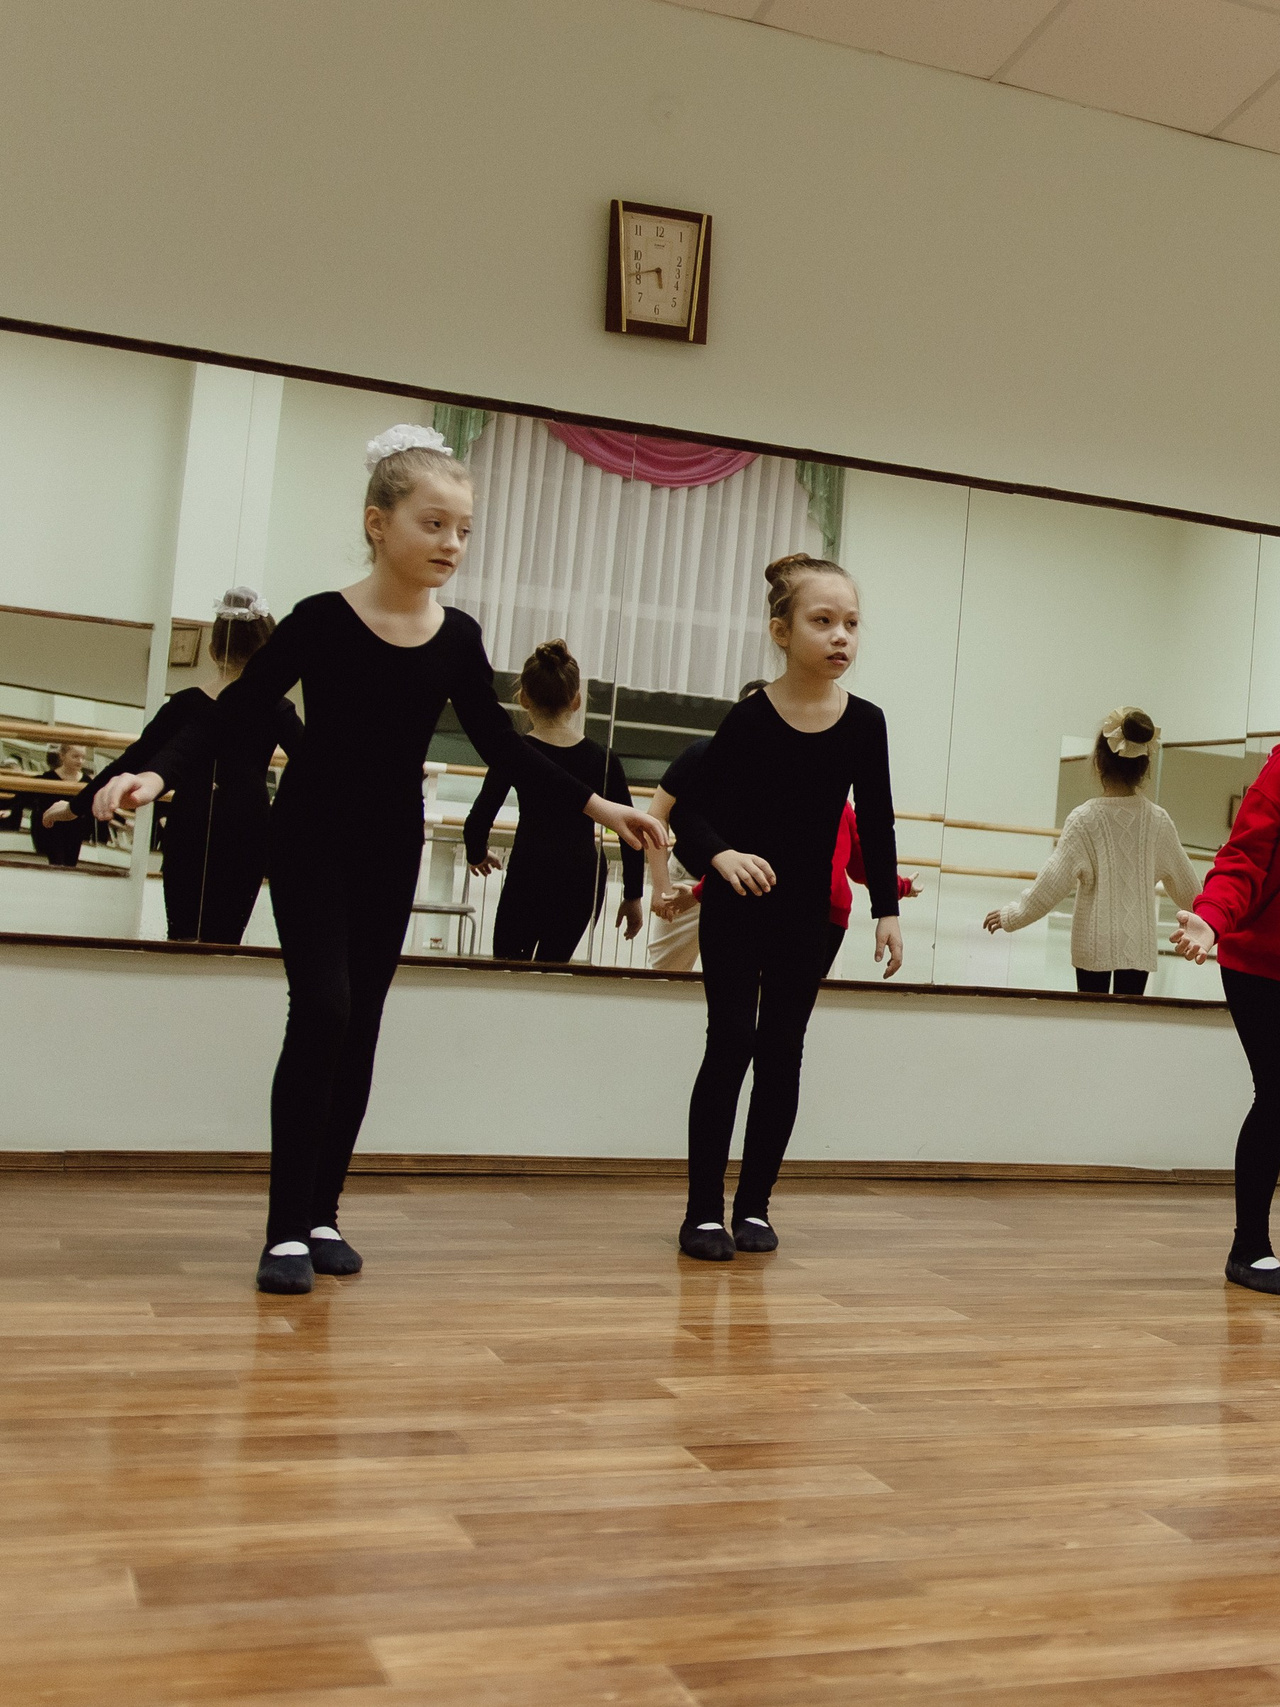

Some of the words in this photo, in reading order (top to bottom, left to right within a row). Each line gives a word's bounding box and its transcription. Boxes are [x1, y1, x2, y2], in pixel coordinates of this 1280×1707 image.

[634, 224, 642, 236] 11
[655, 226, 665, 238] 12
[634, 250, 642, 261] 10
[635, 262, 641, 272] 9
[676, 256, 682, 267] 2
[675, 268, 680, 279] 3
[635, 274, 641, 285] 8
[674, 281, 679, 291] 4
[637, 292, 643, 302] 7
[671, 297, 677, 308] 5
[654, 304, 660, 315] 6
